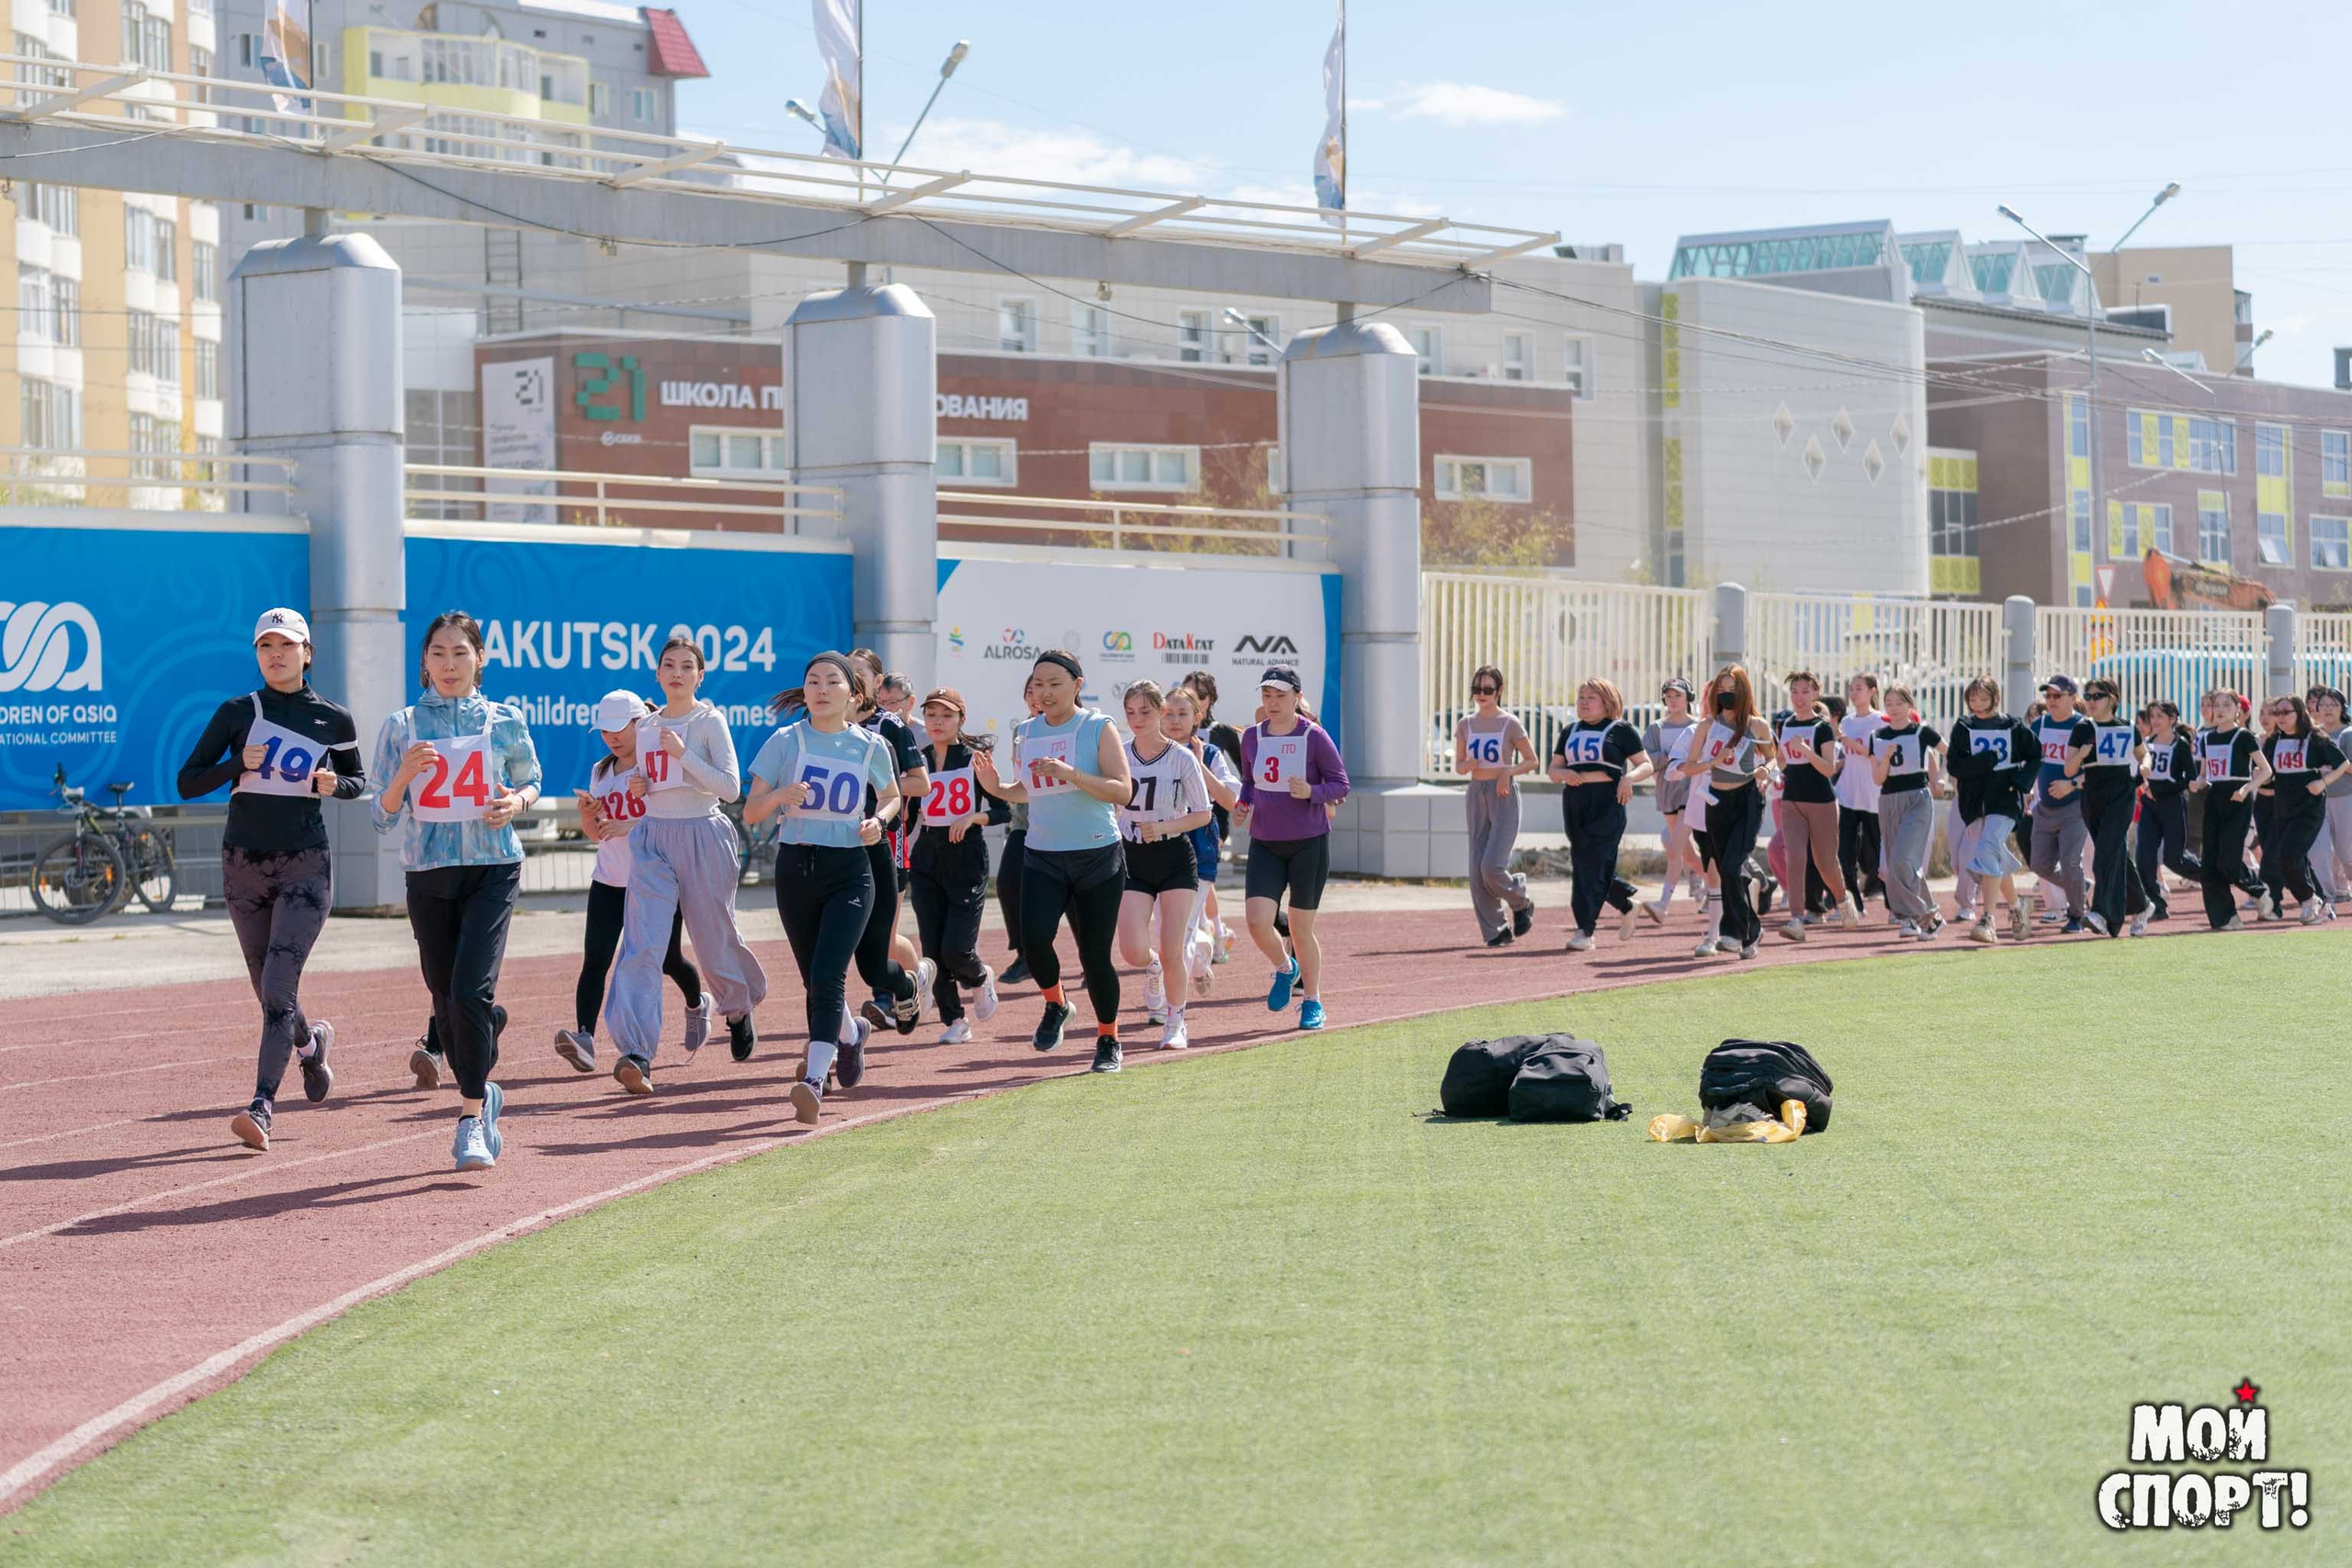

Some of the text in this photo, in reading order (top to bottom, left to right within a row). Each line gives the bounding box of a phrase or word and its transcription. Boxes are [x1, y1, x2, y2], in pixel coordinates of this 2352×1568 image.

[661, 380, 755, 409] ШКОЛА
[984, 645, 1042, 660] ALROSA
[46, 705, 70, 724] OF
[50, 731, 117, 745] COMMITTEE
[1567, 737, 1600, 762] 15
[2098, 732, 2132, 759] 47
[1468, 739, 1499, 763] 16
[2277, 751, 2303, 769] 149
[419, 750, 489, 808] 24
[1264, 756, 1280, 784] 3
[2207, 758, 2227, 776] 151
[799, 765, 860, 815] 50
[926, 777, 972, 817] 28
